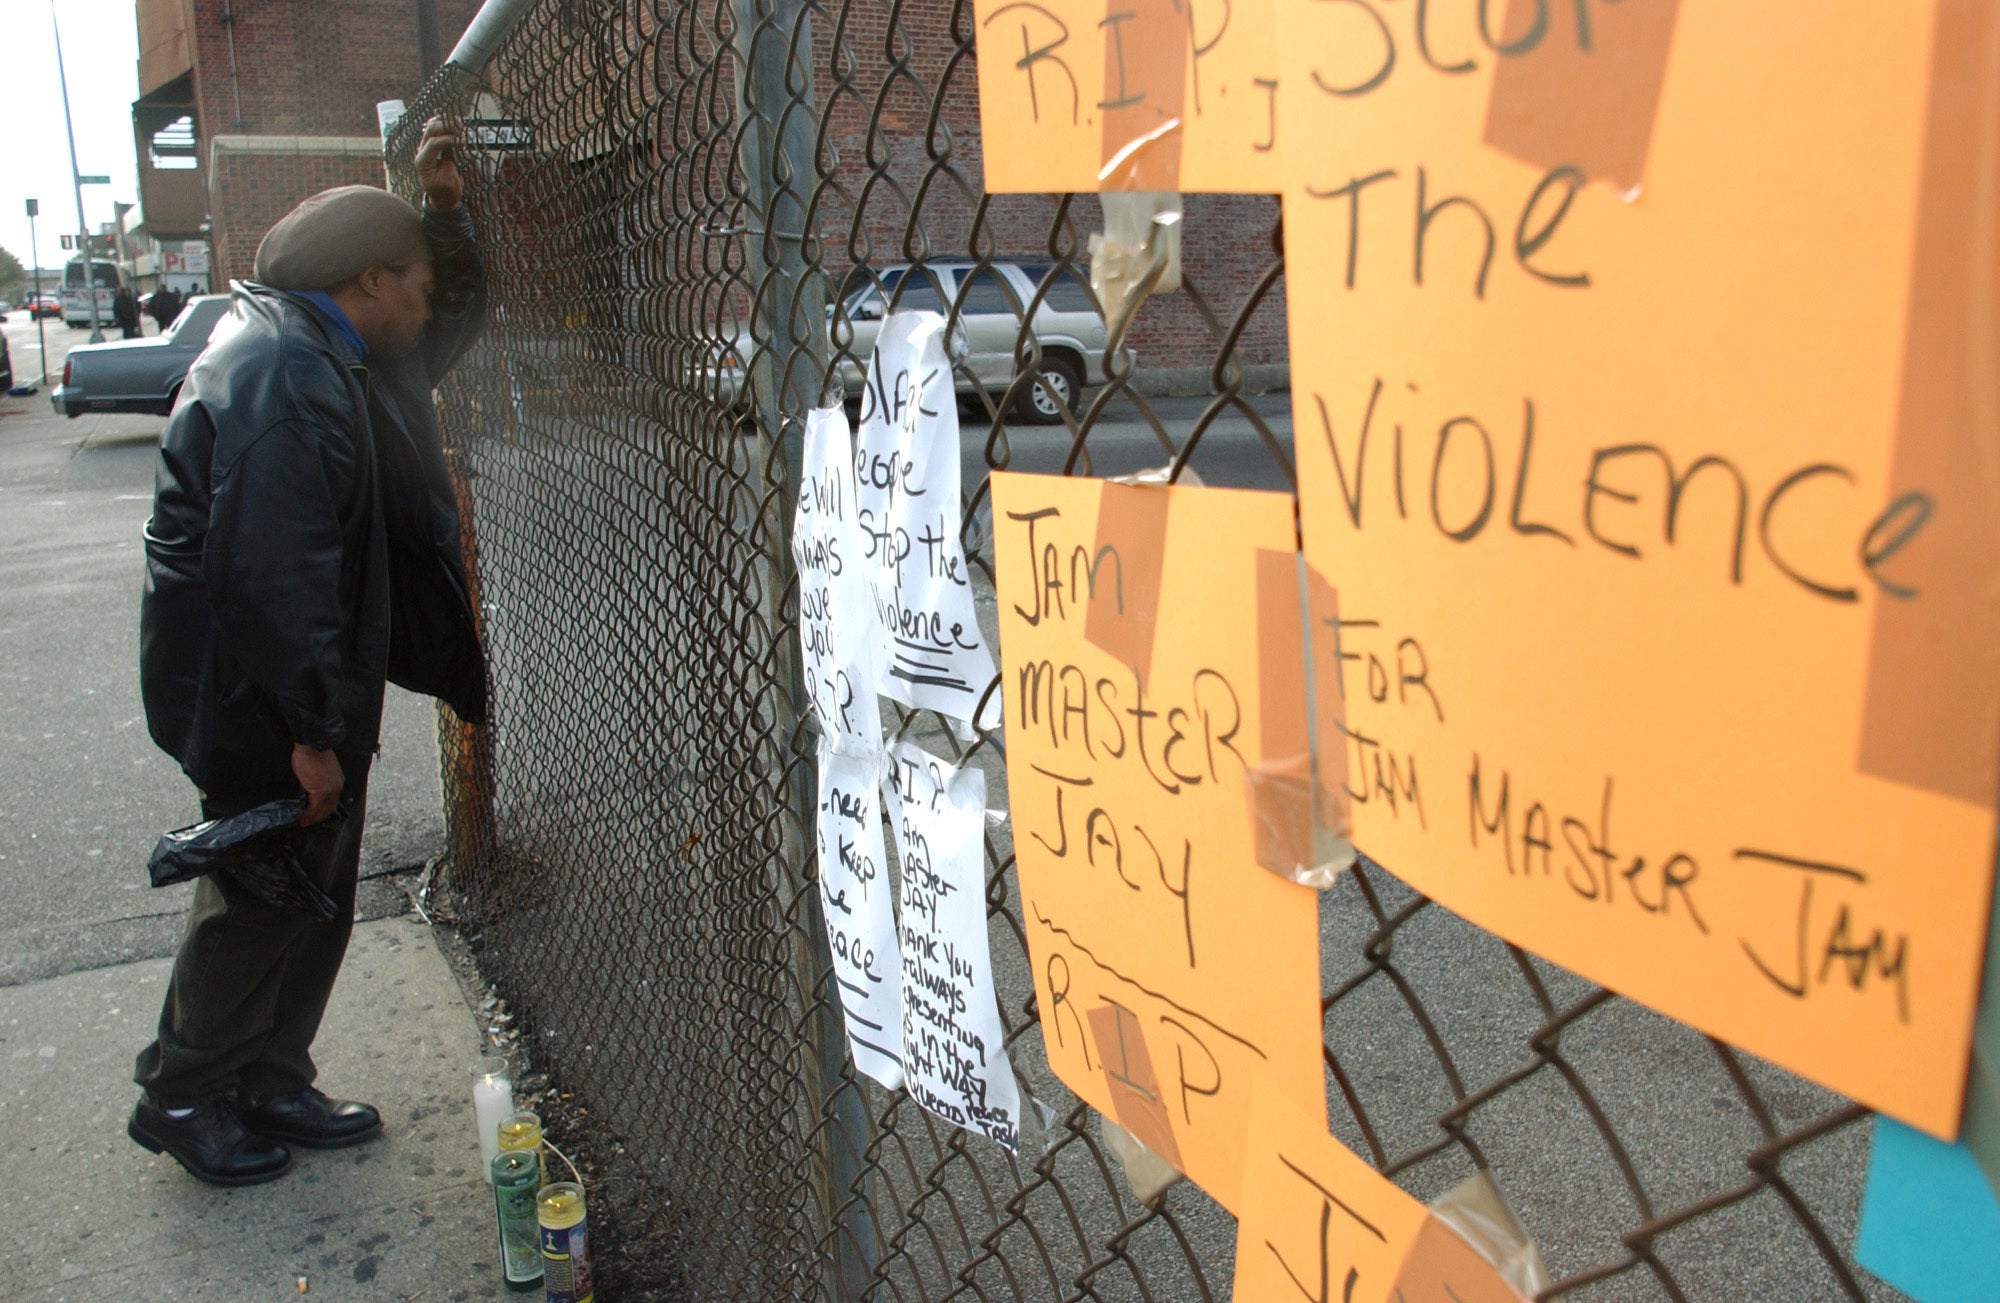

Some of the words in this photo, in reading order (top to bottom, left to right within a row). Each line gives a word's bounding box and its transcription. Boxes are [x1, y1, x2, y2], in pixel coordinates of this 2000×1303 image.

[1306, 164, 1591, 301] The
[859, 509, 911, 589] Stop
[917, 513, 967, 586] the
[1332, 717, 1427, 832] JAM
[829, 922, 883, 984] eace
